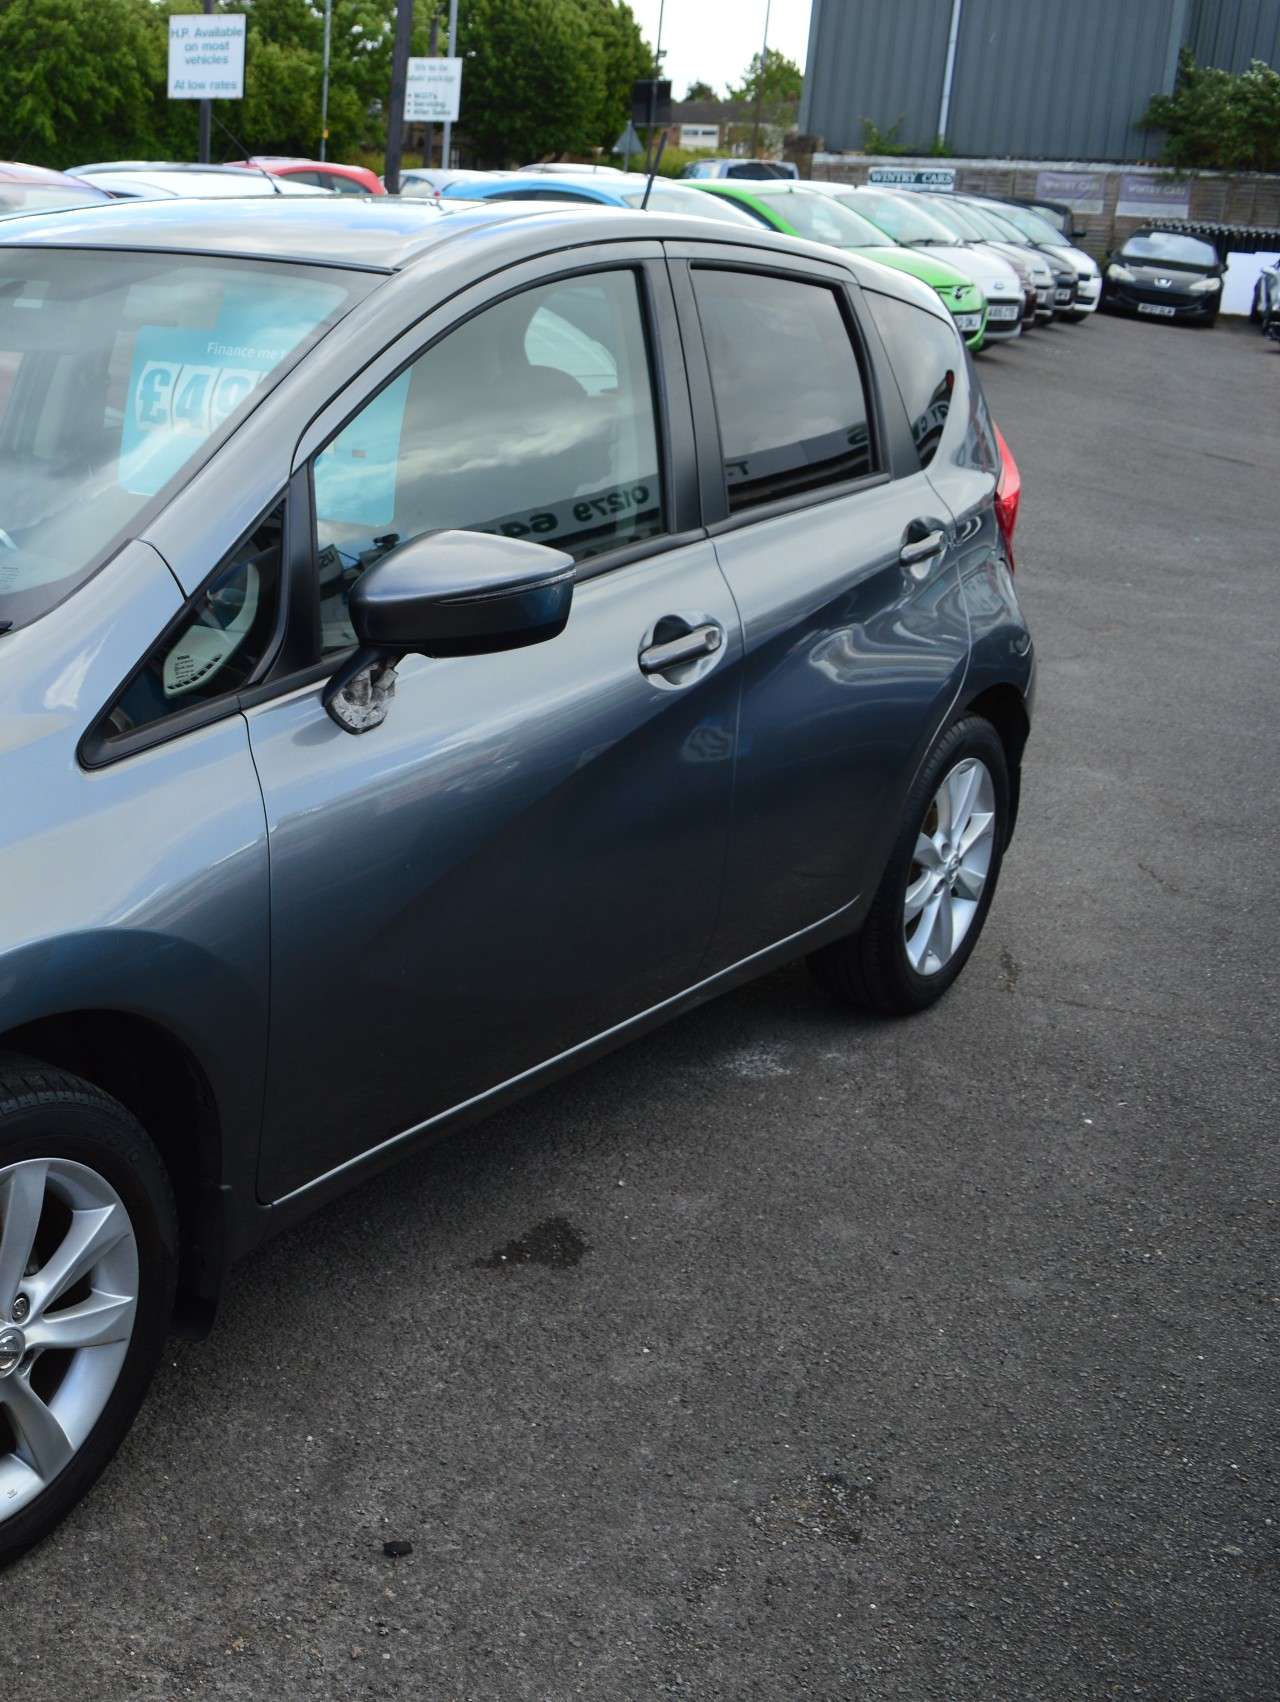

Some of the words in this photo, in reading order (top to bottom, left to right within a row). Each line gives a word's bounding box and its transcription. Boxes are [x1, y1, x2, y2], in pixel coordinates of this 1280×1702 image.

[195, 26, 243, 37] Available
[184, 43, 199, 51] on
[202, 41, 229, 51] most
[185, 53, 229, 64] vehicles
[174, 80, 185, 89] At
[188, 80, 206, 89] low
[210, 80, 237, 89] rates
[871, 170, 916, 184] WINTRY
[207, 342, 253, 359] Finance
[138, 368, 253, 424] £49
